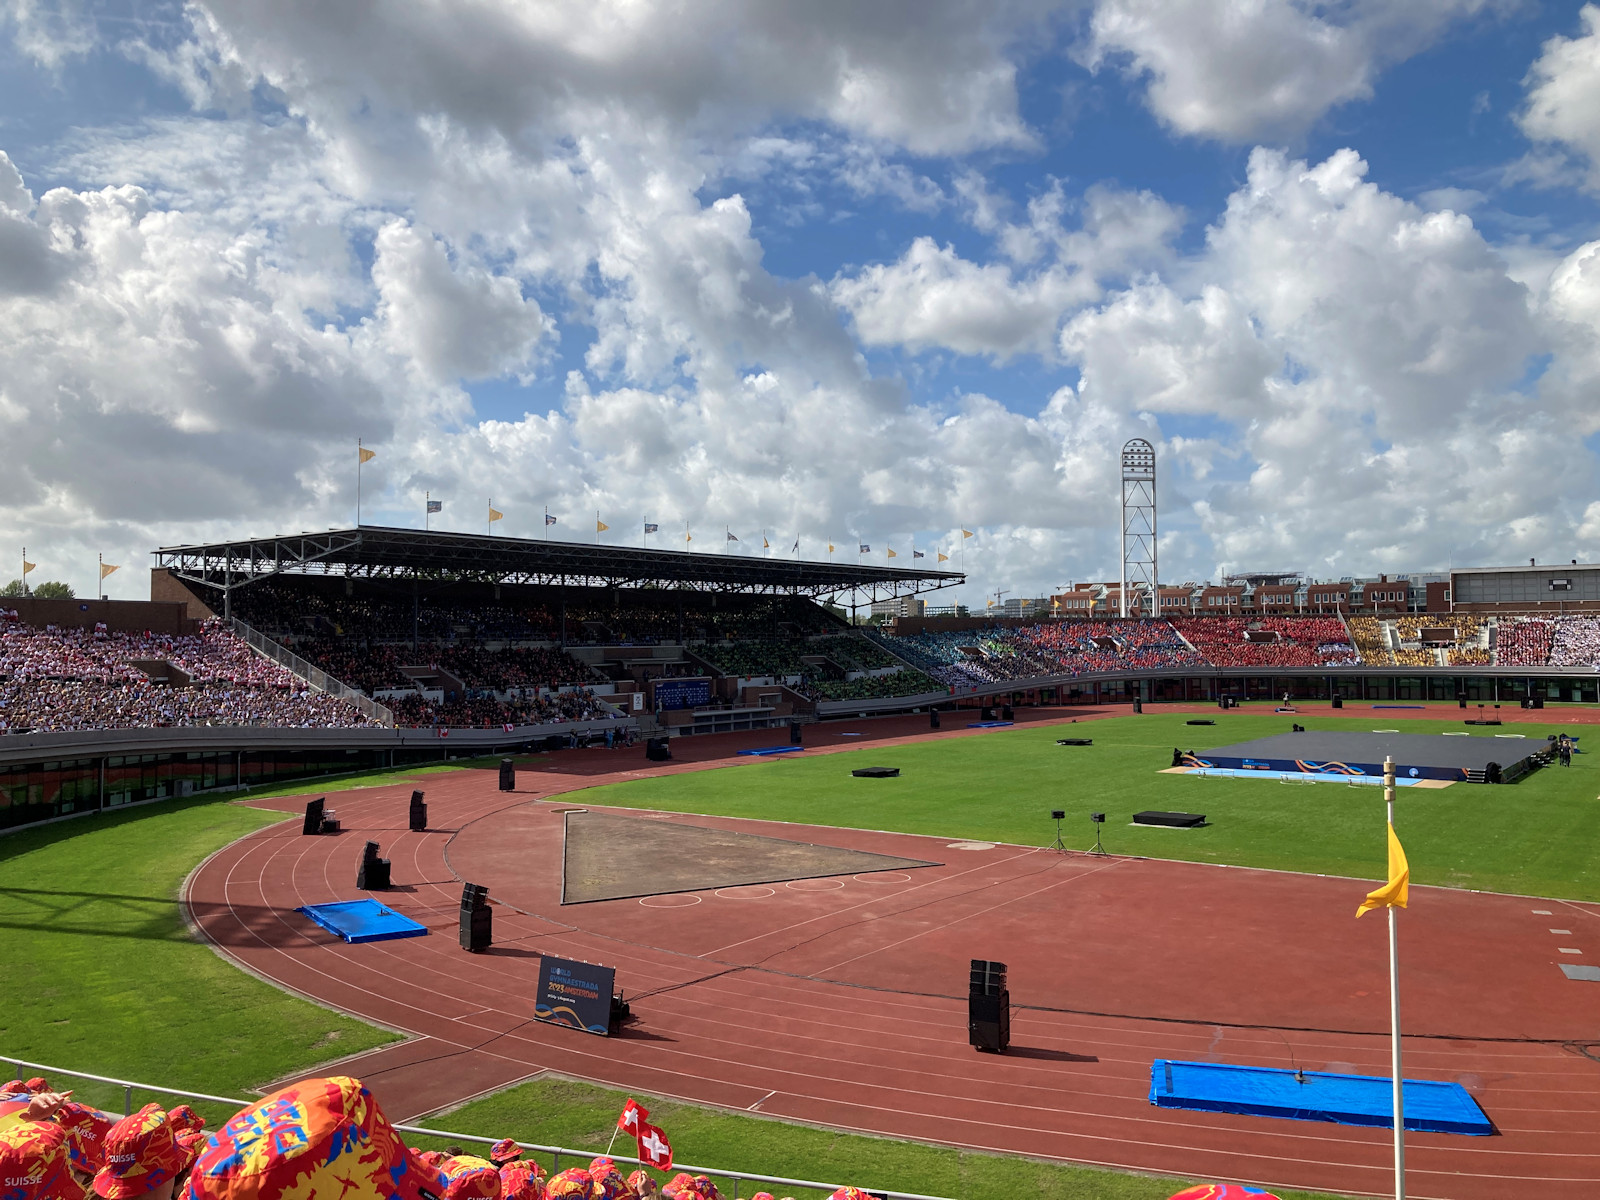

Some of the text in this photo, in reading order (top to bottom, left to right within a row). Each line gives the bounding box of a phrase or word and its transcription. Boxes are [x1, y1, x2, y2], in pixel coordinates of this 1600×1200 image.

[550, 967, 571, 977] WORLD
[548, 981, 565, 993] 2023
[549, 975, 599, 990] GYMNAESTRADA
[73, 1125, 98, 1141] SUISSE
[110, 1153, 136, 1163] SUISSE
[4, 1175, 43, 1187] SUISSE
